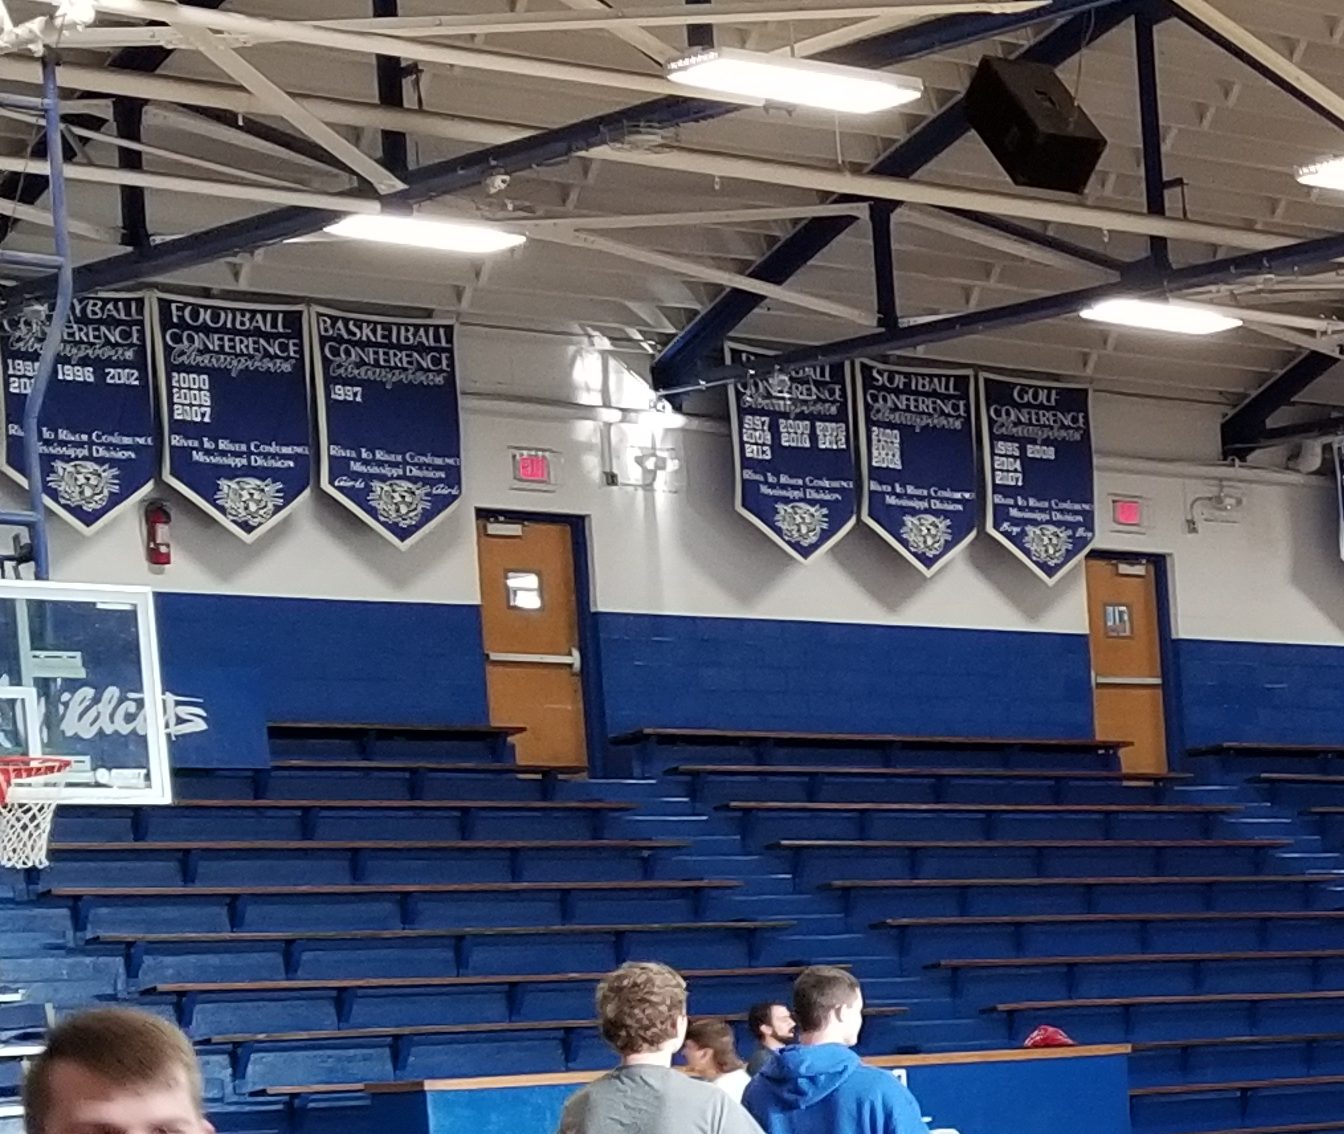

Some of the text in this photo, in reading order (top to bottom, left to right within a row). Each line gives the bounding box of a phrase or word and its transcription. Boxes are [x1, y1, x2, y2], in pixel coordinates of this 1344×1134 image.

[170, 302, 293, 334] FOOTBALL
[165, 327, 301, 359] CONFERENCE
[318, 316, 453, 348] BASKETBALL
[170, 343, 297, 378] Champions
[323, 341, 451, 372] CONFERENCE
[56, 363, 95, 383] 1996
[171, 371, 210, 391] 2000
[329, 358, 450, 390] Champions
[872, 367, 961, 395] SOFTBALL
[172, 388, 212, 406] 2006
[330, 384, 363, 402] 1997
[866, 389, 968, 417] CONFERENCE
[1013, 384, 1060, 407] GOLF
[173, 403, 212, 423] 2007
[989, 404, 1086, 428] CONFERENCE
[38, 442, 89, 459] ississippi
[191, 450, 296, 468] Mississippi Division
[349, 460, 446, 479] Mississippi Division
